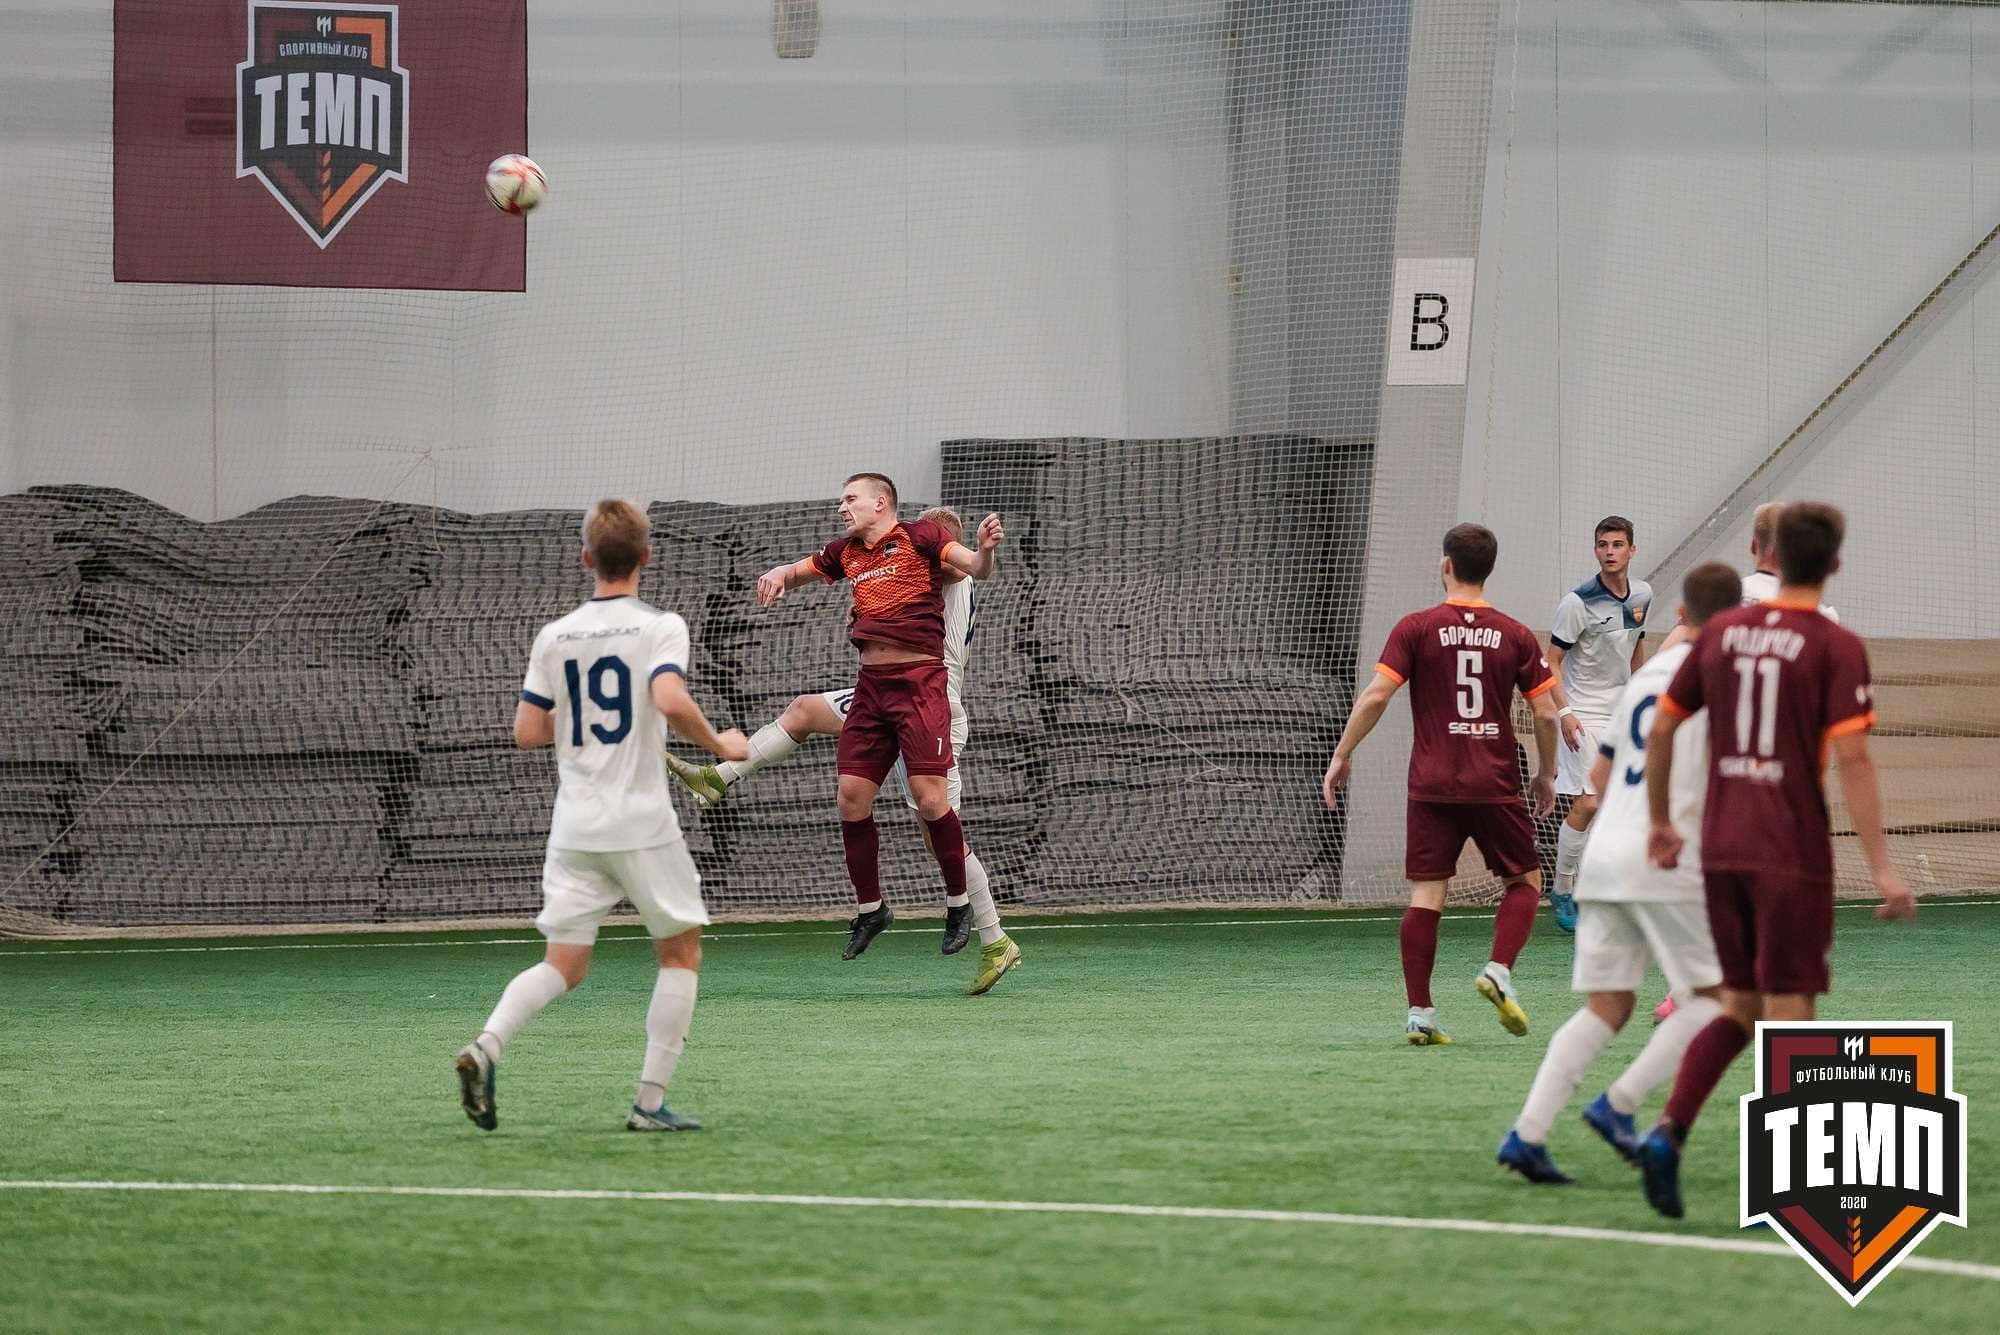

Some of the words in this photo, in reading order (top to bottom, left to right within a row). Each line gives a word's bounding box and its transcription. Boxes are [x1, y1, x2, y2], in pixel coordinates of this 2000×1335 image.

[280, 41, 341, 57] СПОРТИВНЫЙ
[344, 44, 368, 59] КЛУБ
[254, 71, 391, 155] ТЕМП
[1438, 626, 1502, 649] БОРИСОВ
[564, 655, 632, 747] 19
[1456, 650, 1483, 719] 5
[1733, 656, 1781, 757] 11
[1448, 722, 1500, 735] SEUS
